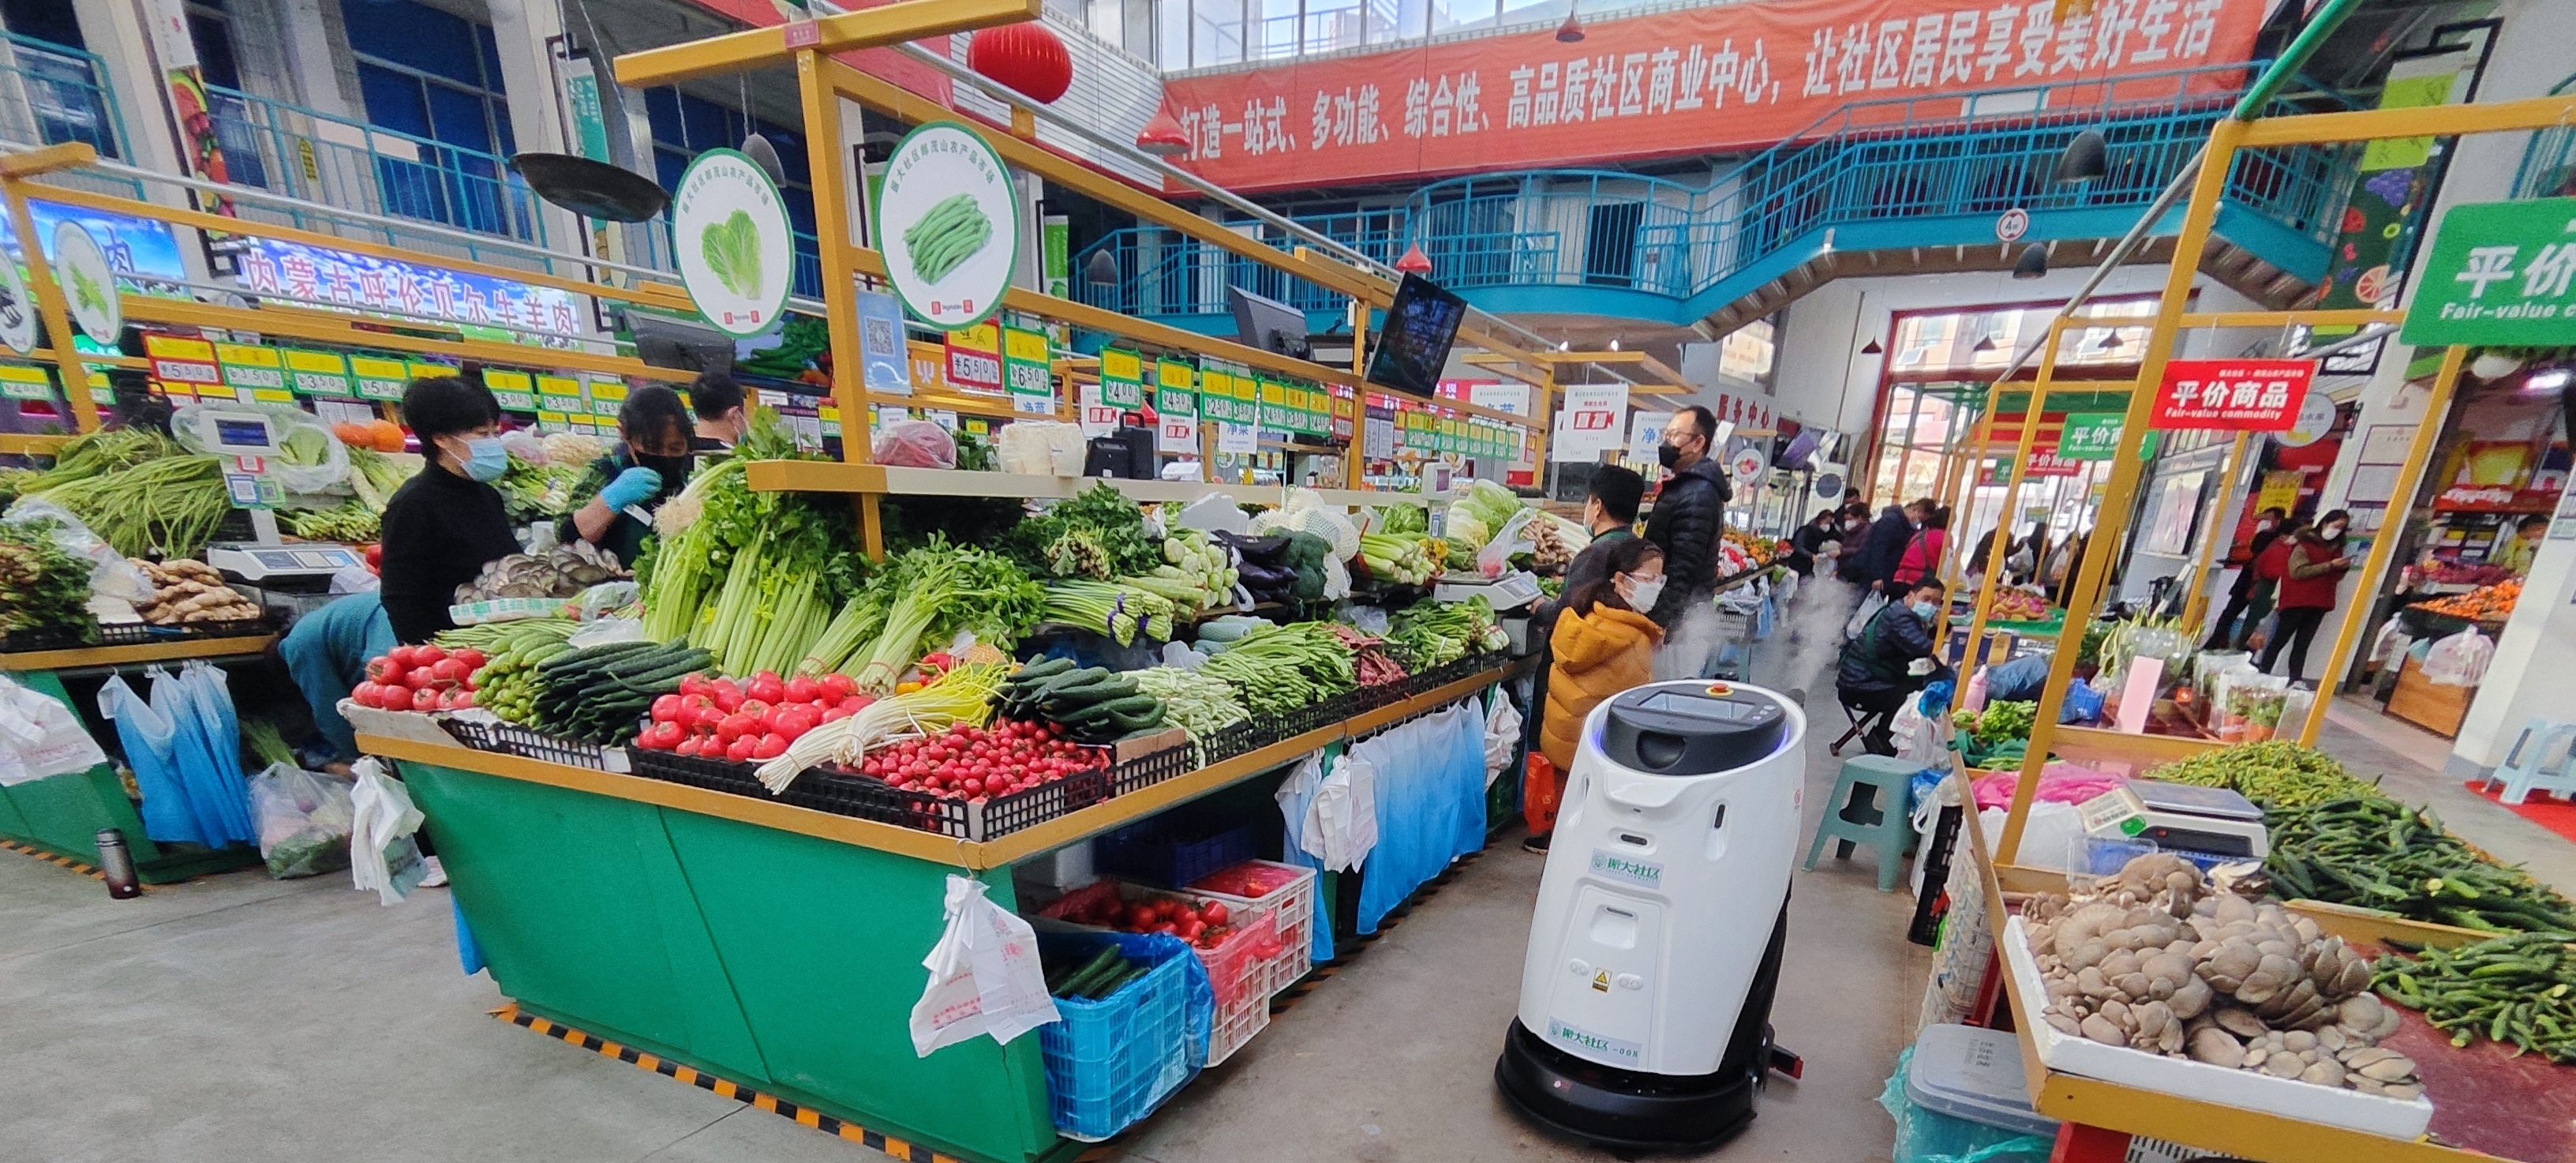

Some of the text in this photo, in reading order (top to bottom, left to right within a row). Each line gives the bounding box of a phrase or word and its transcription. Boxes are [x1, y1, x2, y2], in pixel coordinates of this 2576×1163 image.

[245, 250, 575, 335] 内蒙古呼伦贝尔牛羊肉
[2439, 301, 2557, 320] Fair-value
[2171, 380, 2289, 409] 平价商品
[2165, 407, 2282, 421] Fair-value commodity
